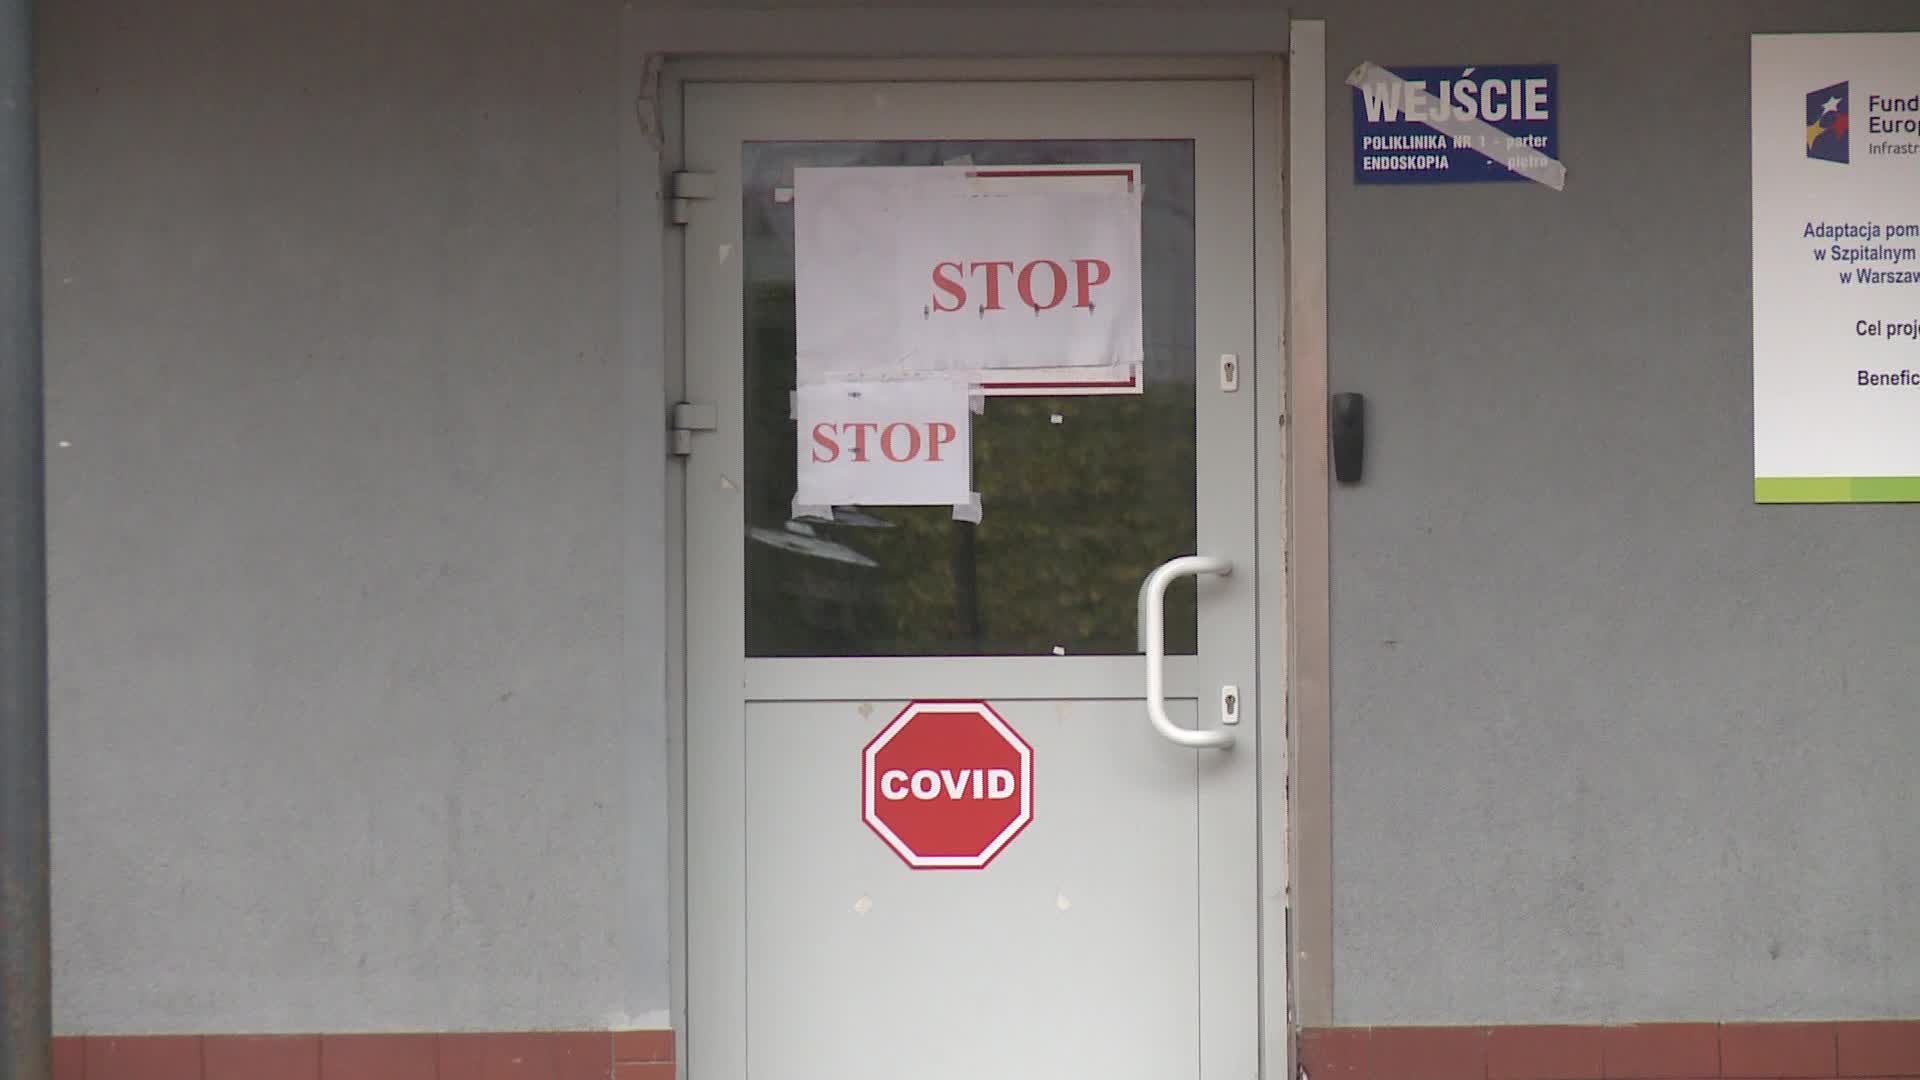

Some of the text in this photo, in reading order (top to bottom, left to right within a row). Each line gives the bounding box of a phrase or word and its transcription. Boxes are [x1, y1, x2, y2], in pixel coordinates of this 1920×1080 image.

[1362, 67, 1549, 122] WEJŚCIE
[1869, 95, 1919, 112] Fund
[1869, 116, 1920, 136] Euro
[1363, 135, 1447, 150] POLIKLINIKA
[1453, 135, 1472, 149] NR
[1506, 134, 1548, 151] parter
[1869, 141, 1920, 154] Infrastr
[1363, 155, 1449, 170] ENDOSKOPIA
[1803, 221, 1919, 241] Adaptacja pom
[1813, 244, 1916, 264] w Szpitalnym
[931, 258, 1111, 313] STOP
[1839, 271, 1852, 284] w
[1856, 319, 1920, 340] Cel proj
[811, 421, 957, 464] STOP
[880, 769, 1016, 800] COVID
